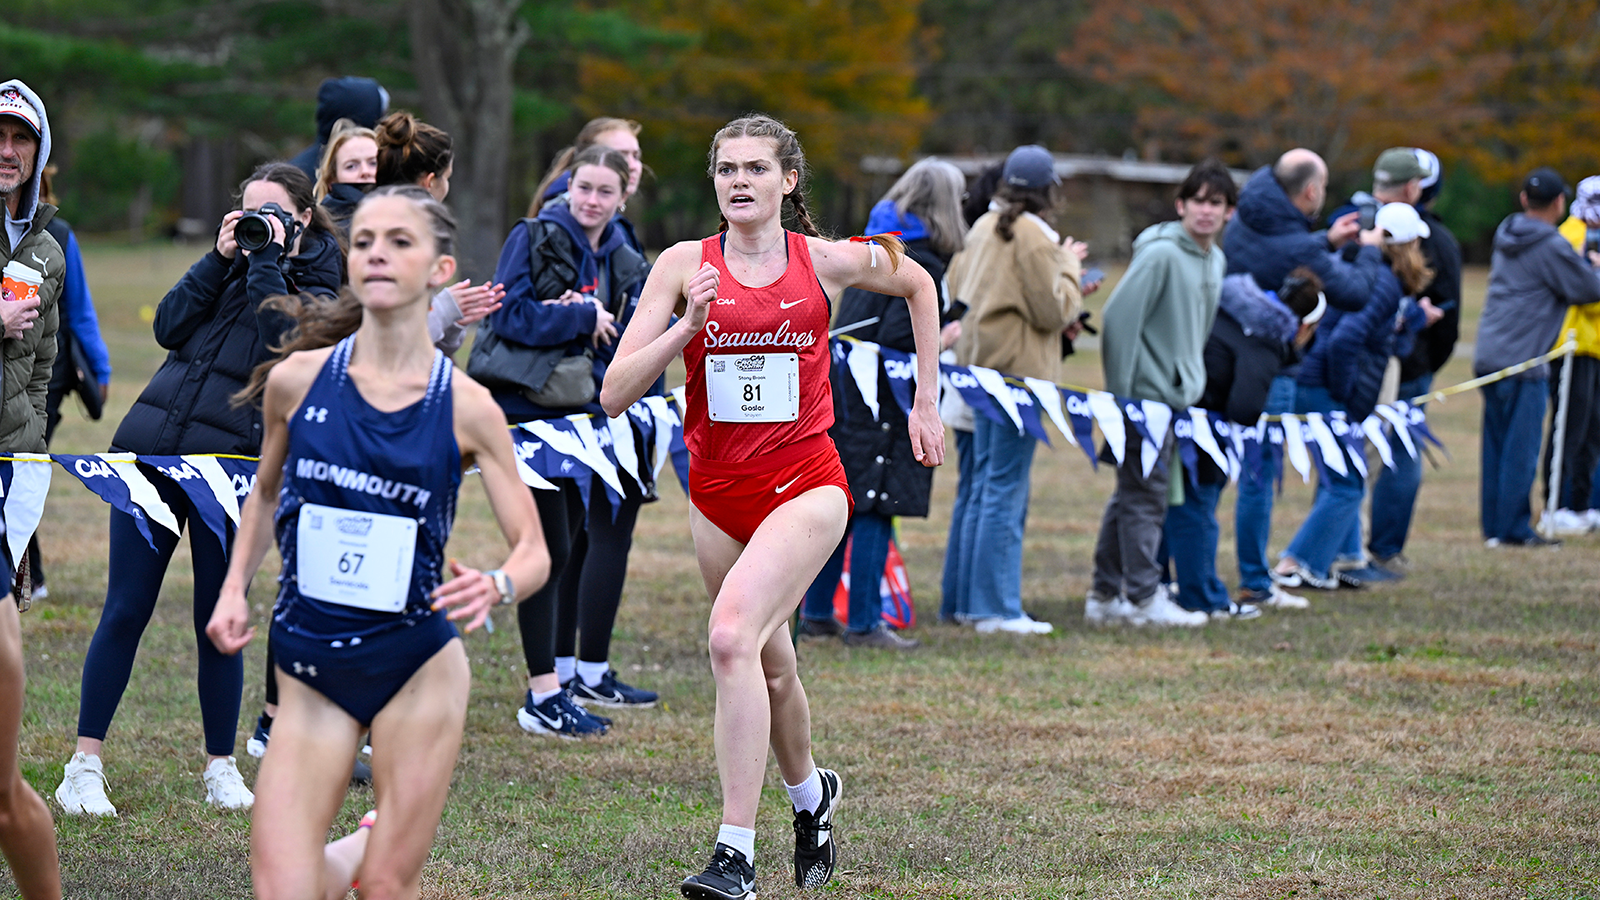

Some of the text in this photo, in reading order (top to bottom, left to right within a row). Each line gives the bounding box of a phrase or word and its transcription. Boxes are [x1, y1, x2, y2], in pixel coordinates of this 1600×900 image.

[704, 319, 816, 348] Seawolves
[743, 384, 761, 402] 81
[75, 459, 118, 478] CAA
[296, 458, 432, 510] MONMOUTH
[338, 551, 364, 575] 67
